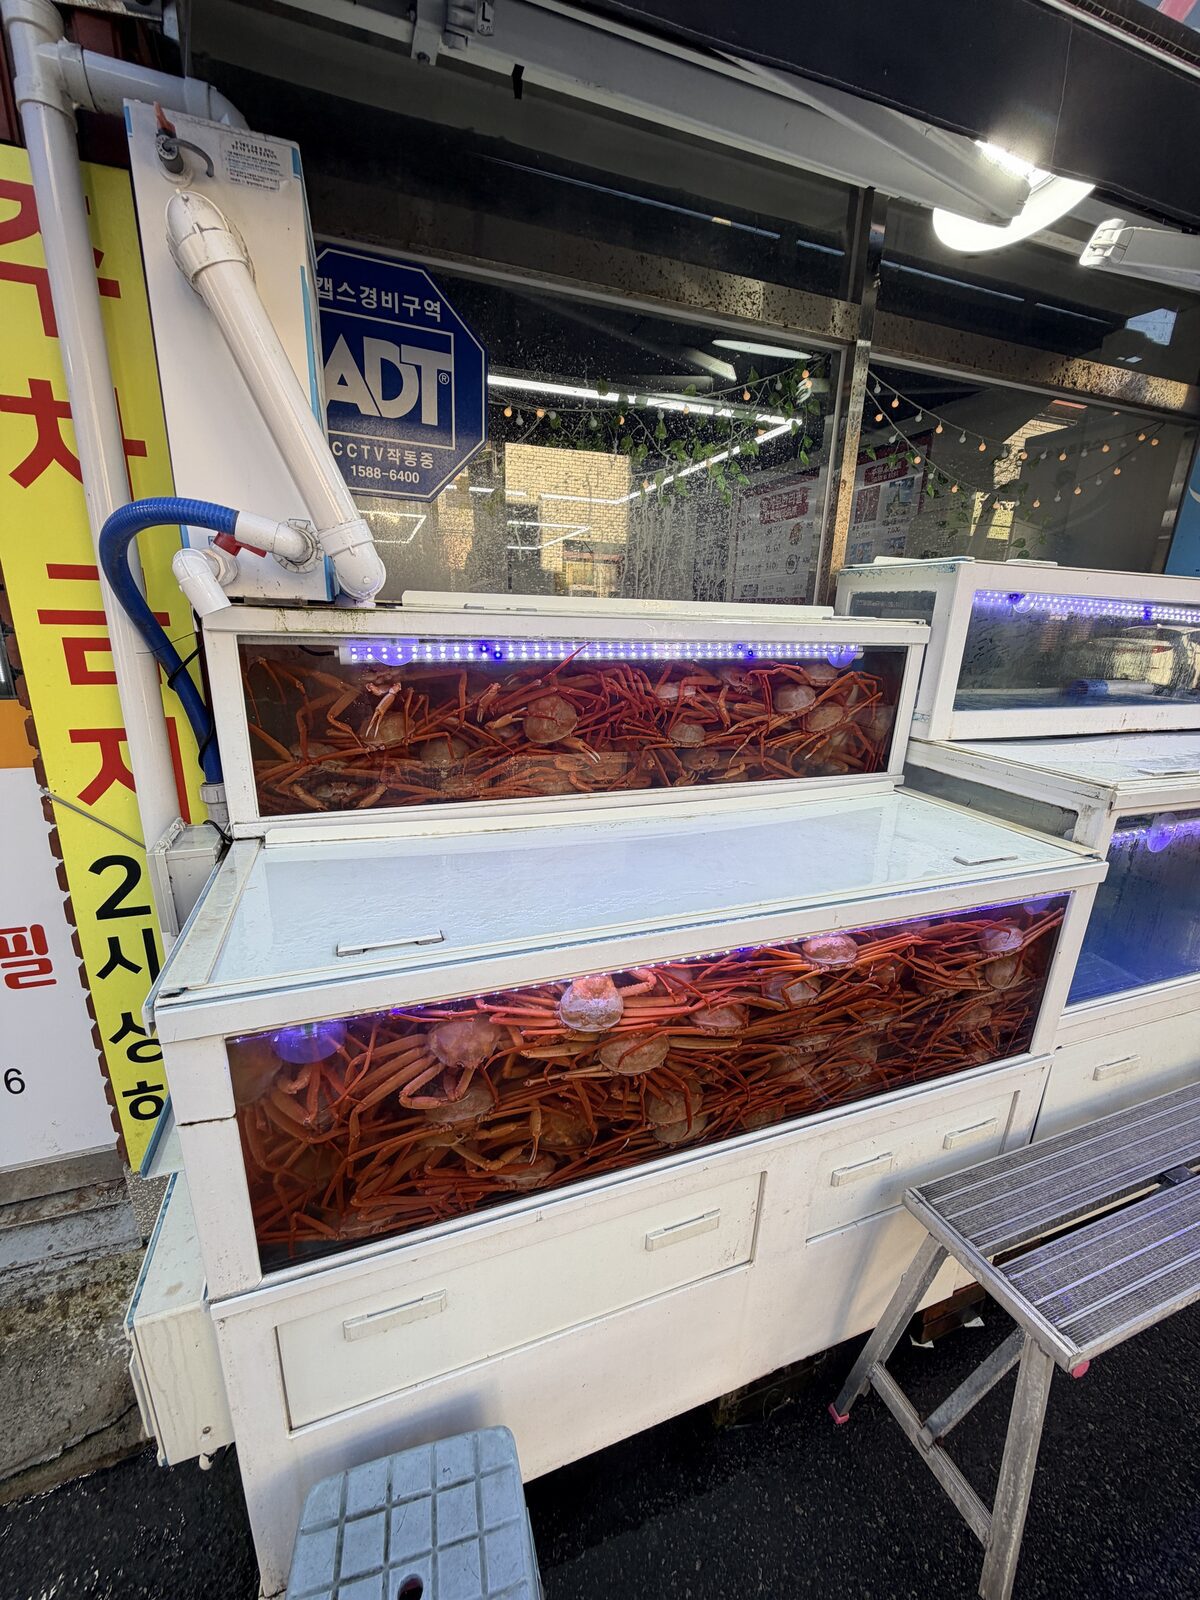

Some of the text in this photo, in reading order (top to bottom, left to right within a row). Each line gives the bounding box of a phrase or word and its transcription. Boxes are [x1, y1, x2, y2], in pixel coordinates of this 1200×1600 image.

[316, 276, 441, 322] 캡스경비구역
[350, 464, 420, 484] 1588-6400
[4, 1067, 26, 1095] 6
